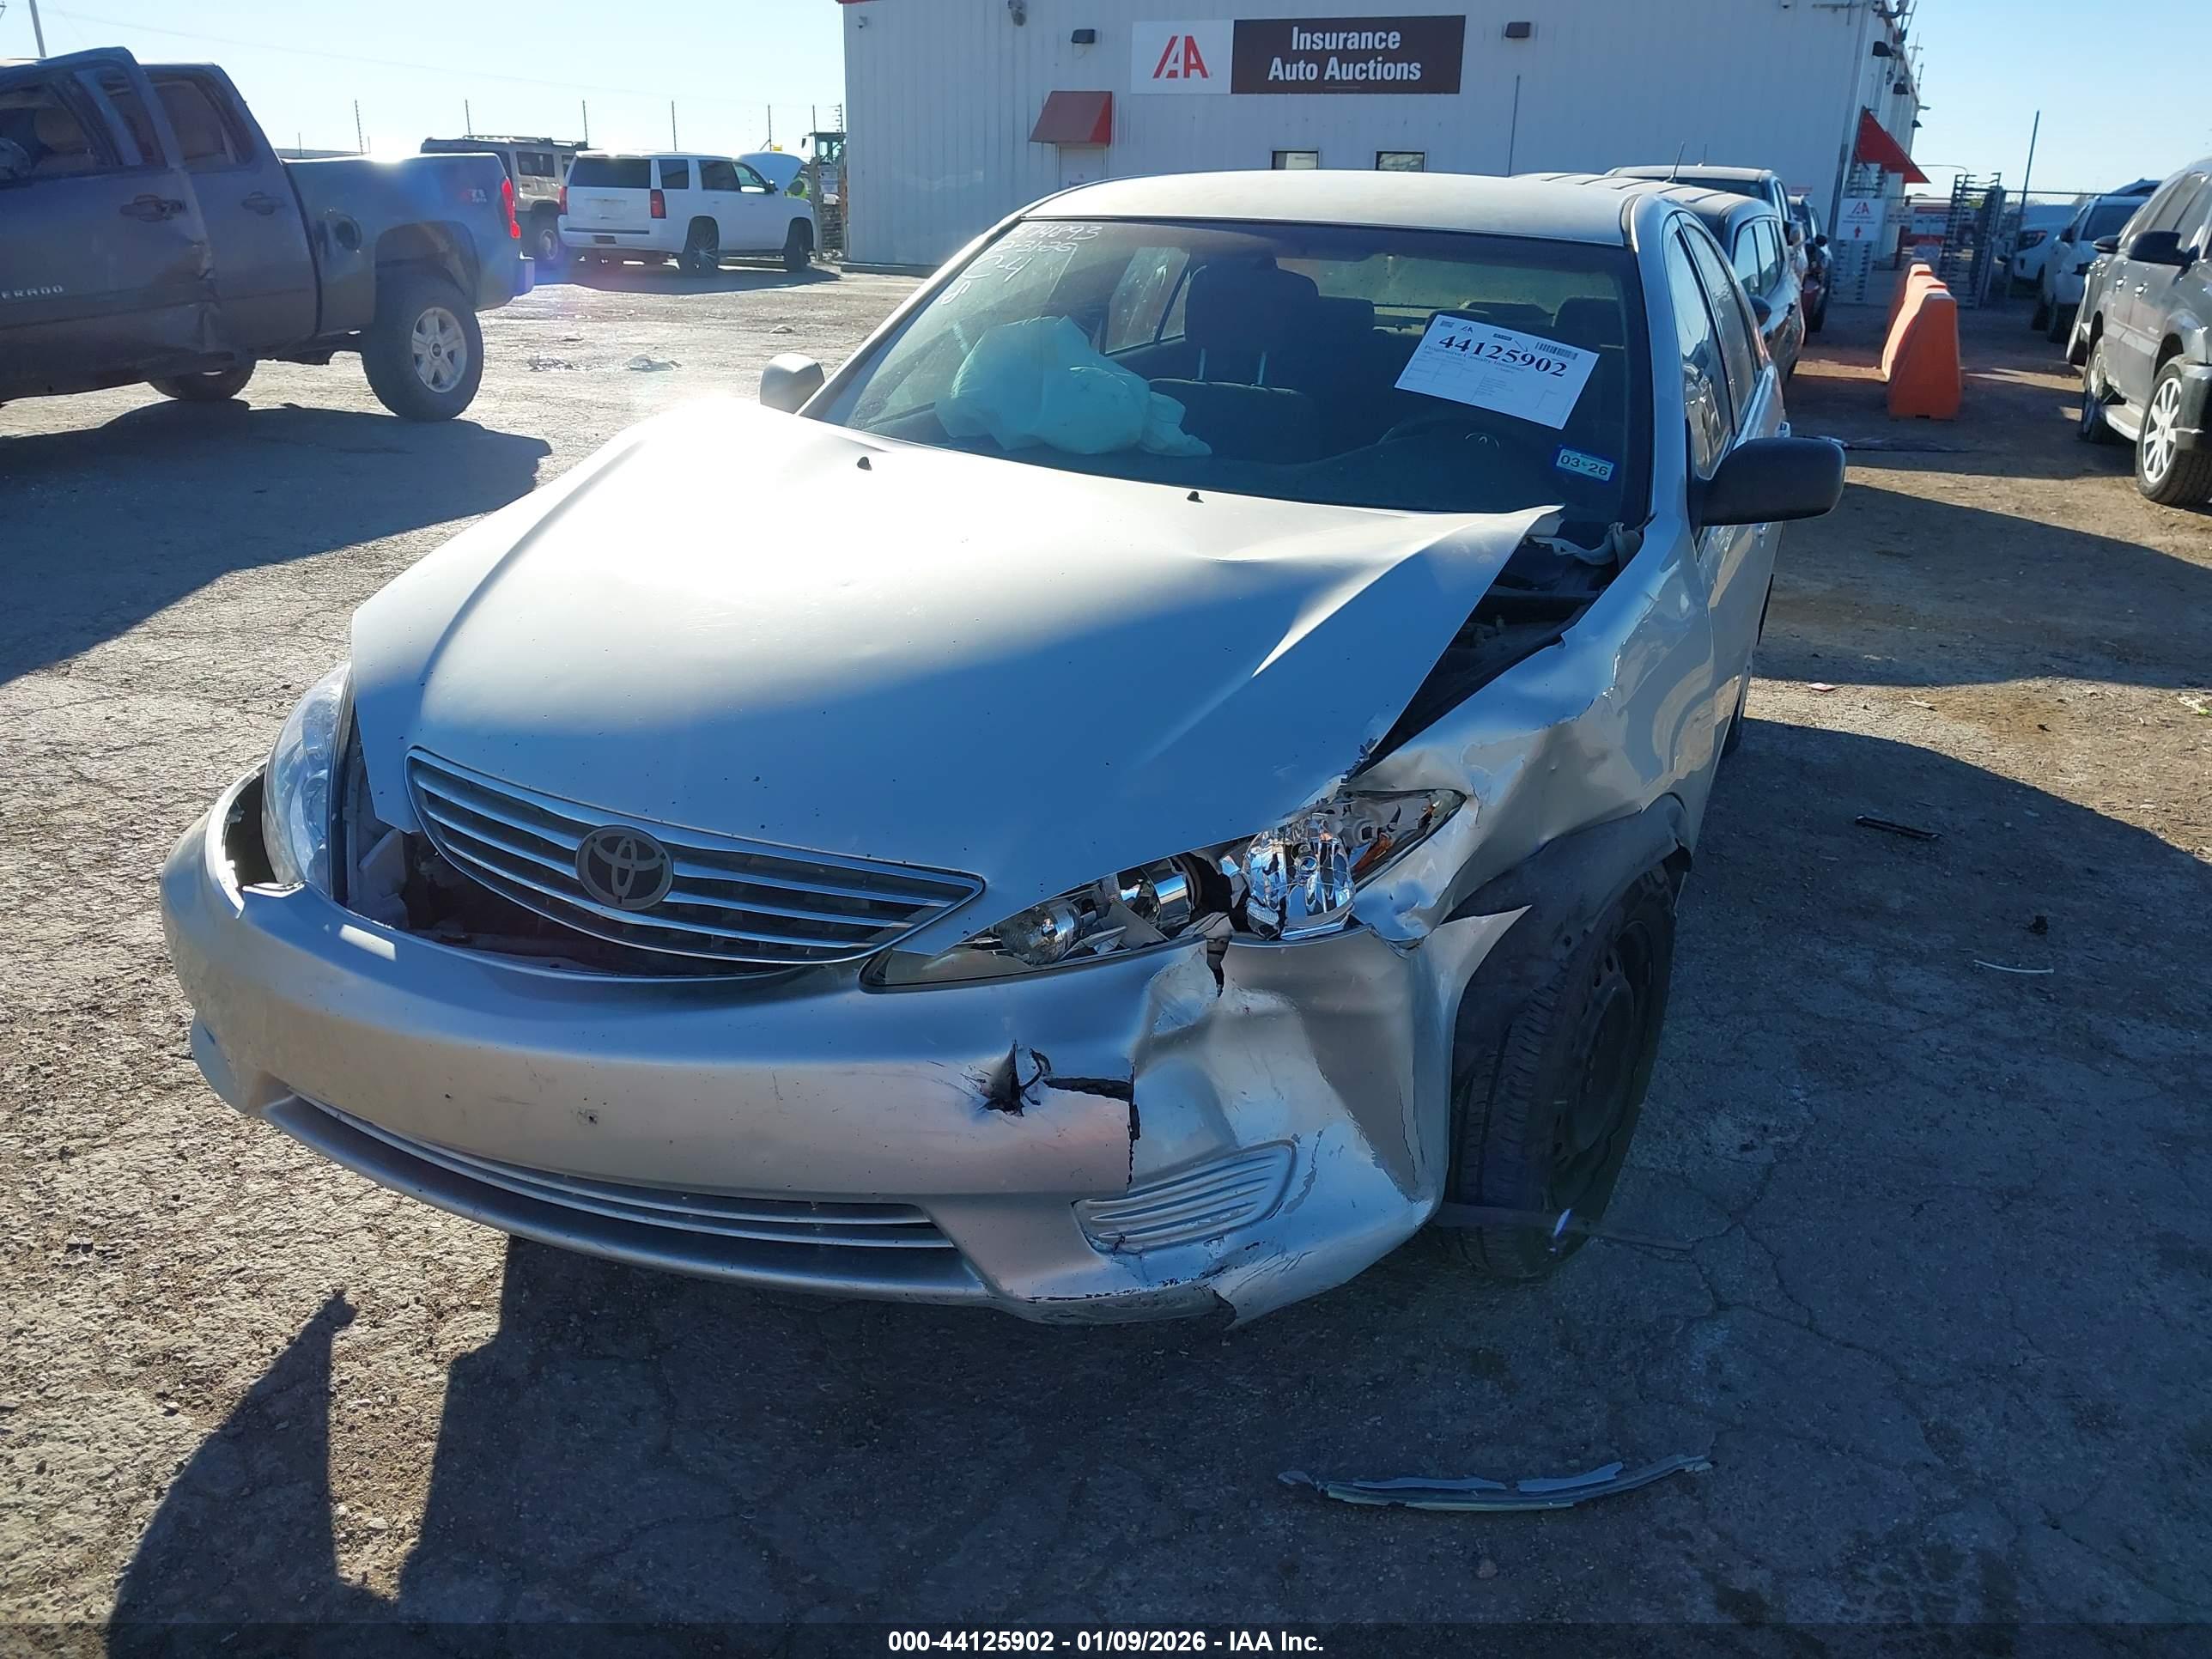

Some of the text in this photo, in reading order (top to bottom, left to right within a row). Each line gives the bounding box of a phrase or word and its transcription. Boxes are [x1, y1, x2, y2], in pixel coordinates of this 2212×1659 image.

[1291, 27, 1401, 51] Insurance
[1267, 56, 1421, 81] Auto Auctions
[1438, 334, 1567, 377] 44125902
